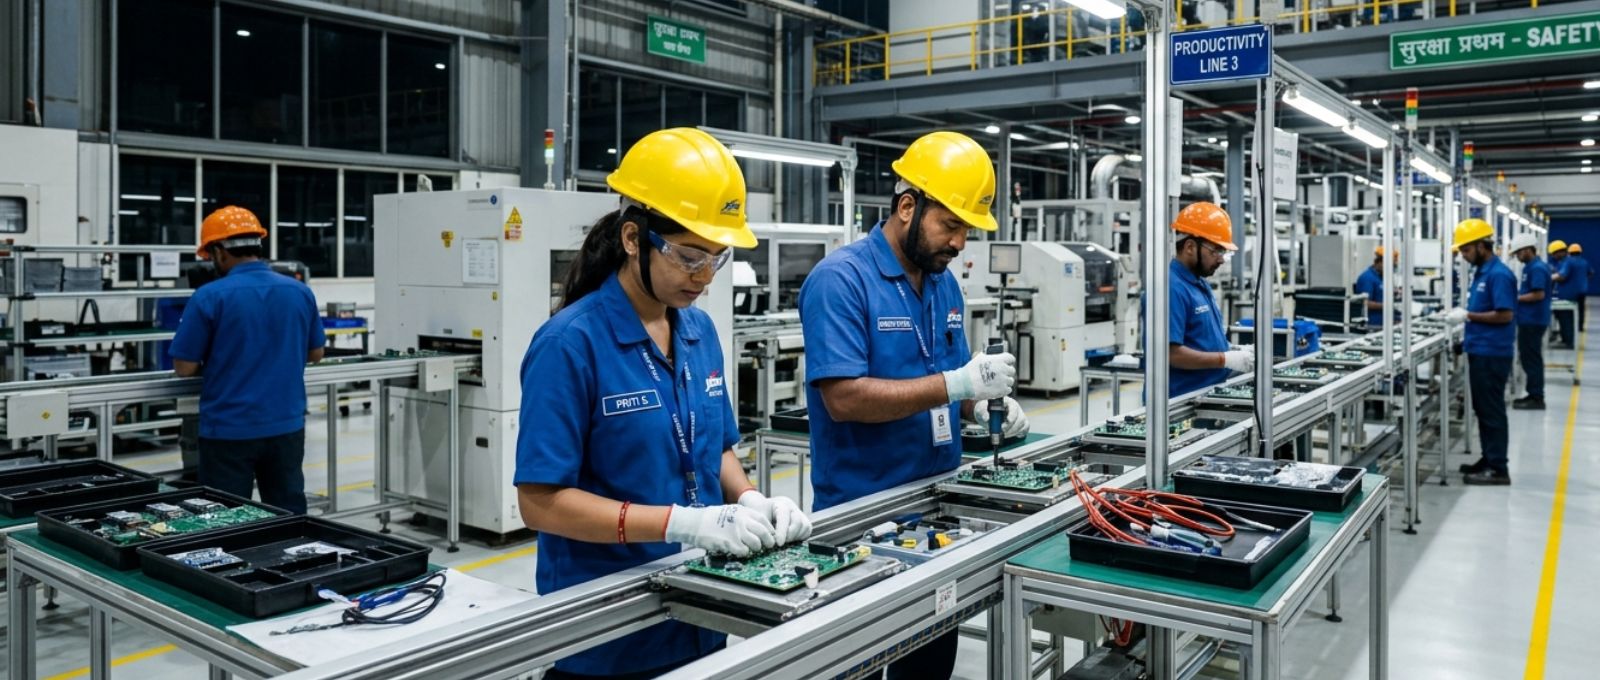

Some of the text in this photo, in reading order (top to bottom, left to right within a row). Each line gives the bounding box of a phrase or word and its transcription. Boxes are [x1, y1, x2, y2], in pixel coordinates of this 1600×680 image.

[1174, 33, 1265, 56] PRODUCTIVITY
[1398, 37, 1451, 64] सुरक्षा
[1458, 32, 1505, 53] प्रथम
[1200, 55, 1239, 73] LINE 3
[641, 395, 649, 405] S
